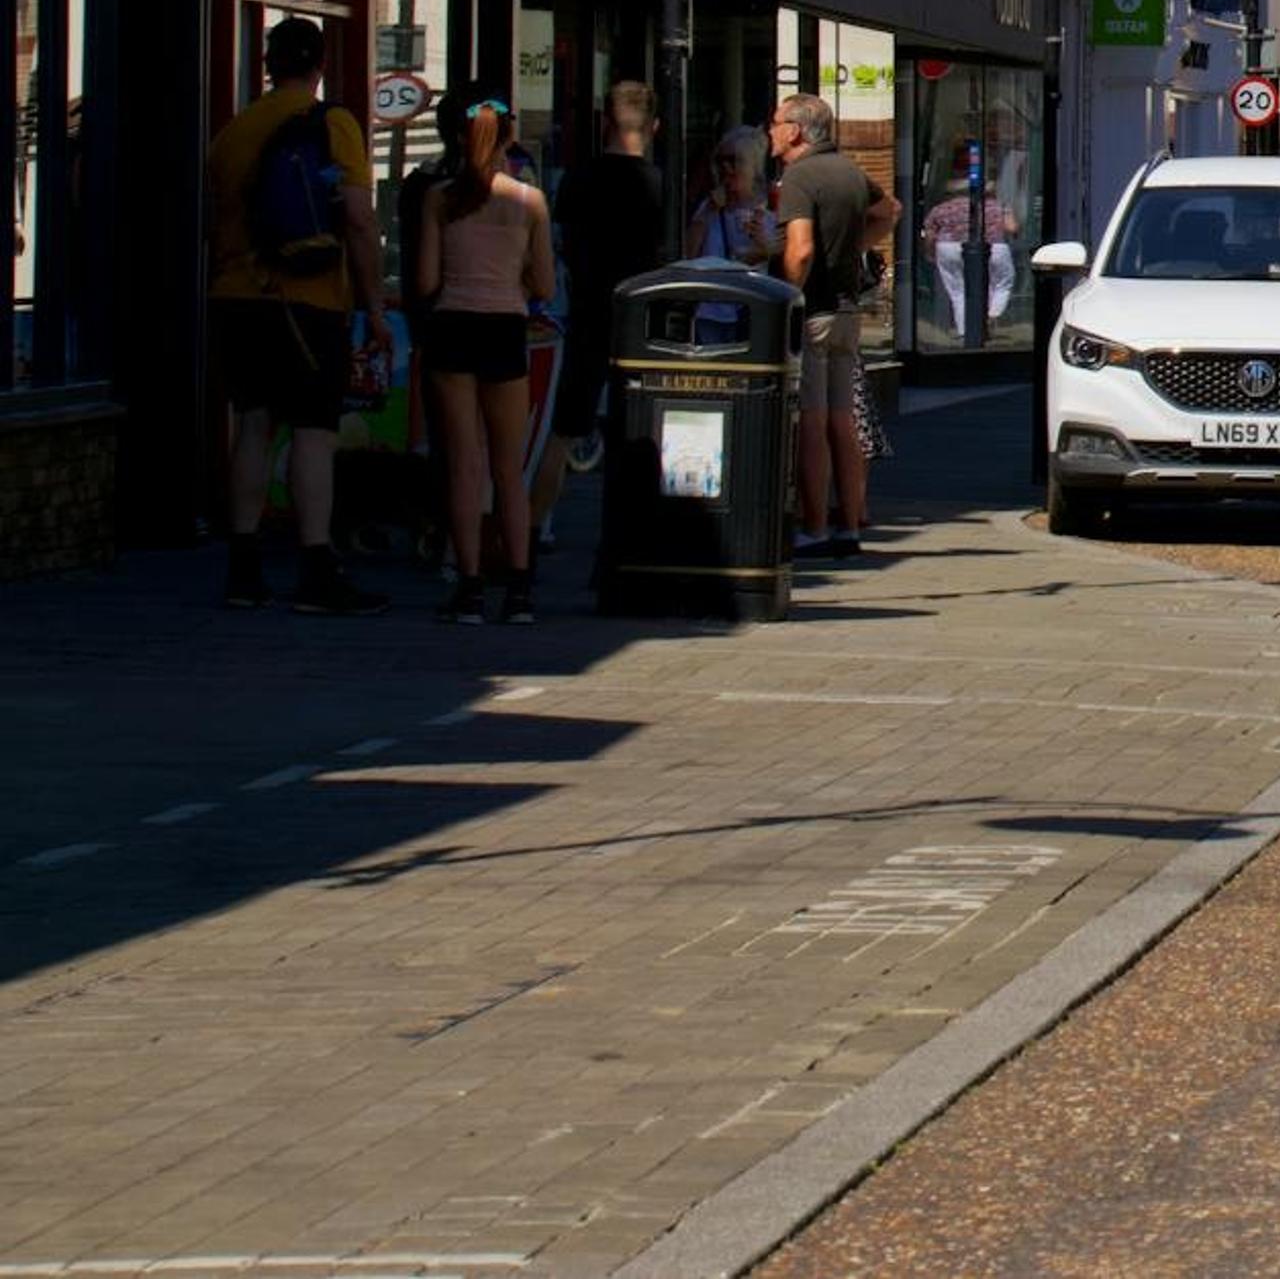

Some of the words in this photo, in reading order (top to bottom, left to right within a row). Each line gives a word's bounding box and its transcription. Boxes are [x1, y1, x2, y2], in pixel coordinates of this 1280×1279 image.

[1104, 20, 1148, 34] OXFAM
[1239, 90, 1271, 110] 20
[1202, 423, 1259, 443] LN69
